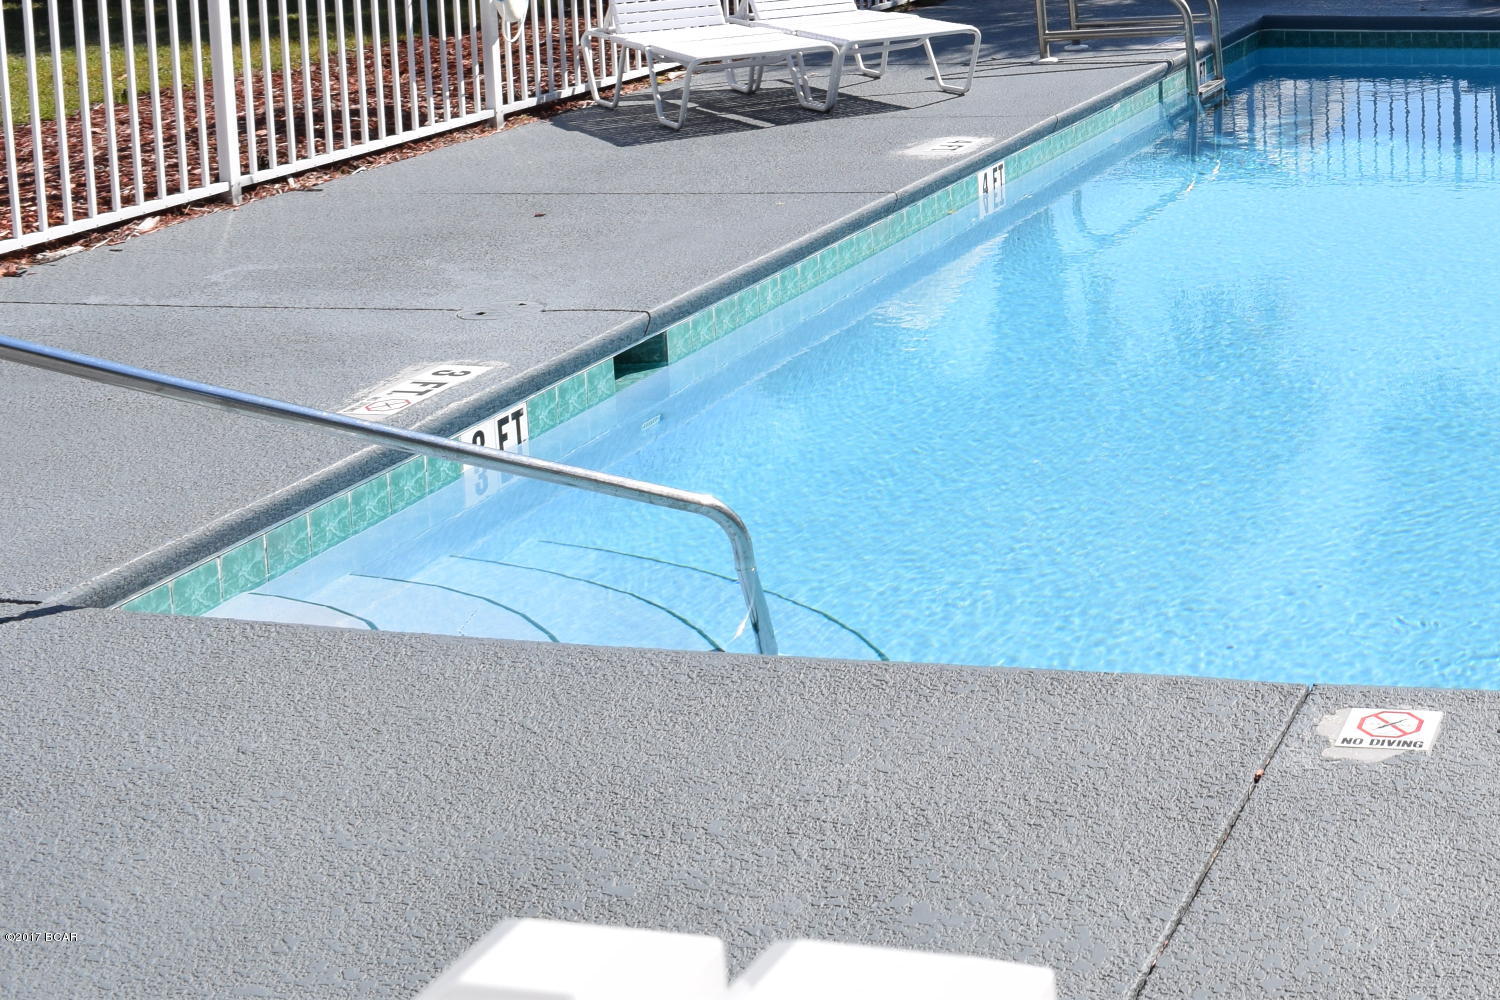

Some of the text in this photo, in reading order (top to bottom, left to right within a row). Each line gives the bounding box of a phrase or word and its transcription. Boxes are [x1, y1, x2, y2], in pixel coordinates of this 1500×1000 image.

[992, 163, 1004, 191] FT
[431, 369, 472, 377] 3
[1340, 736, 1424, 749] NO DIVING
